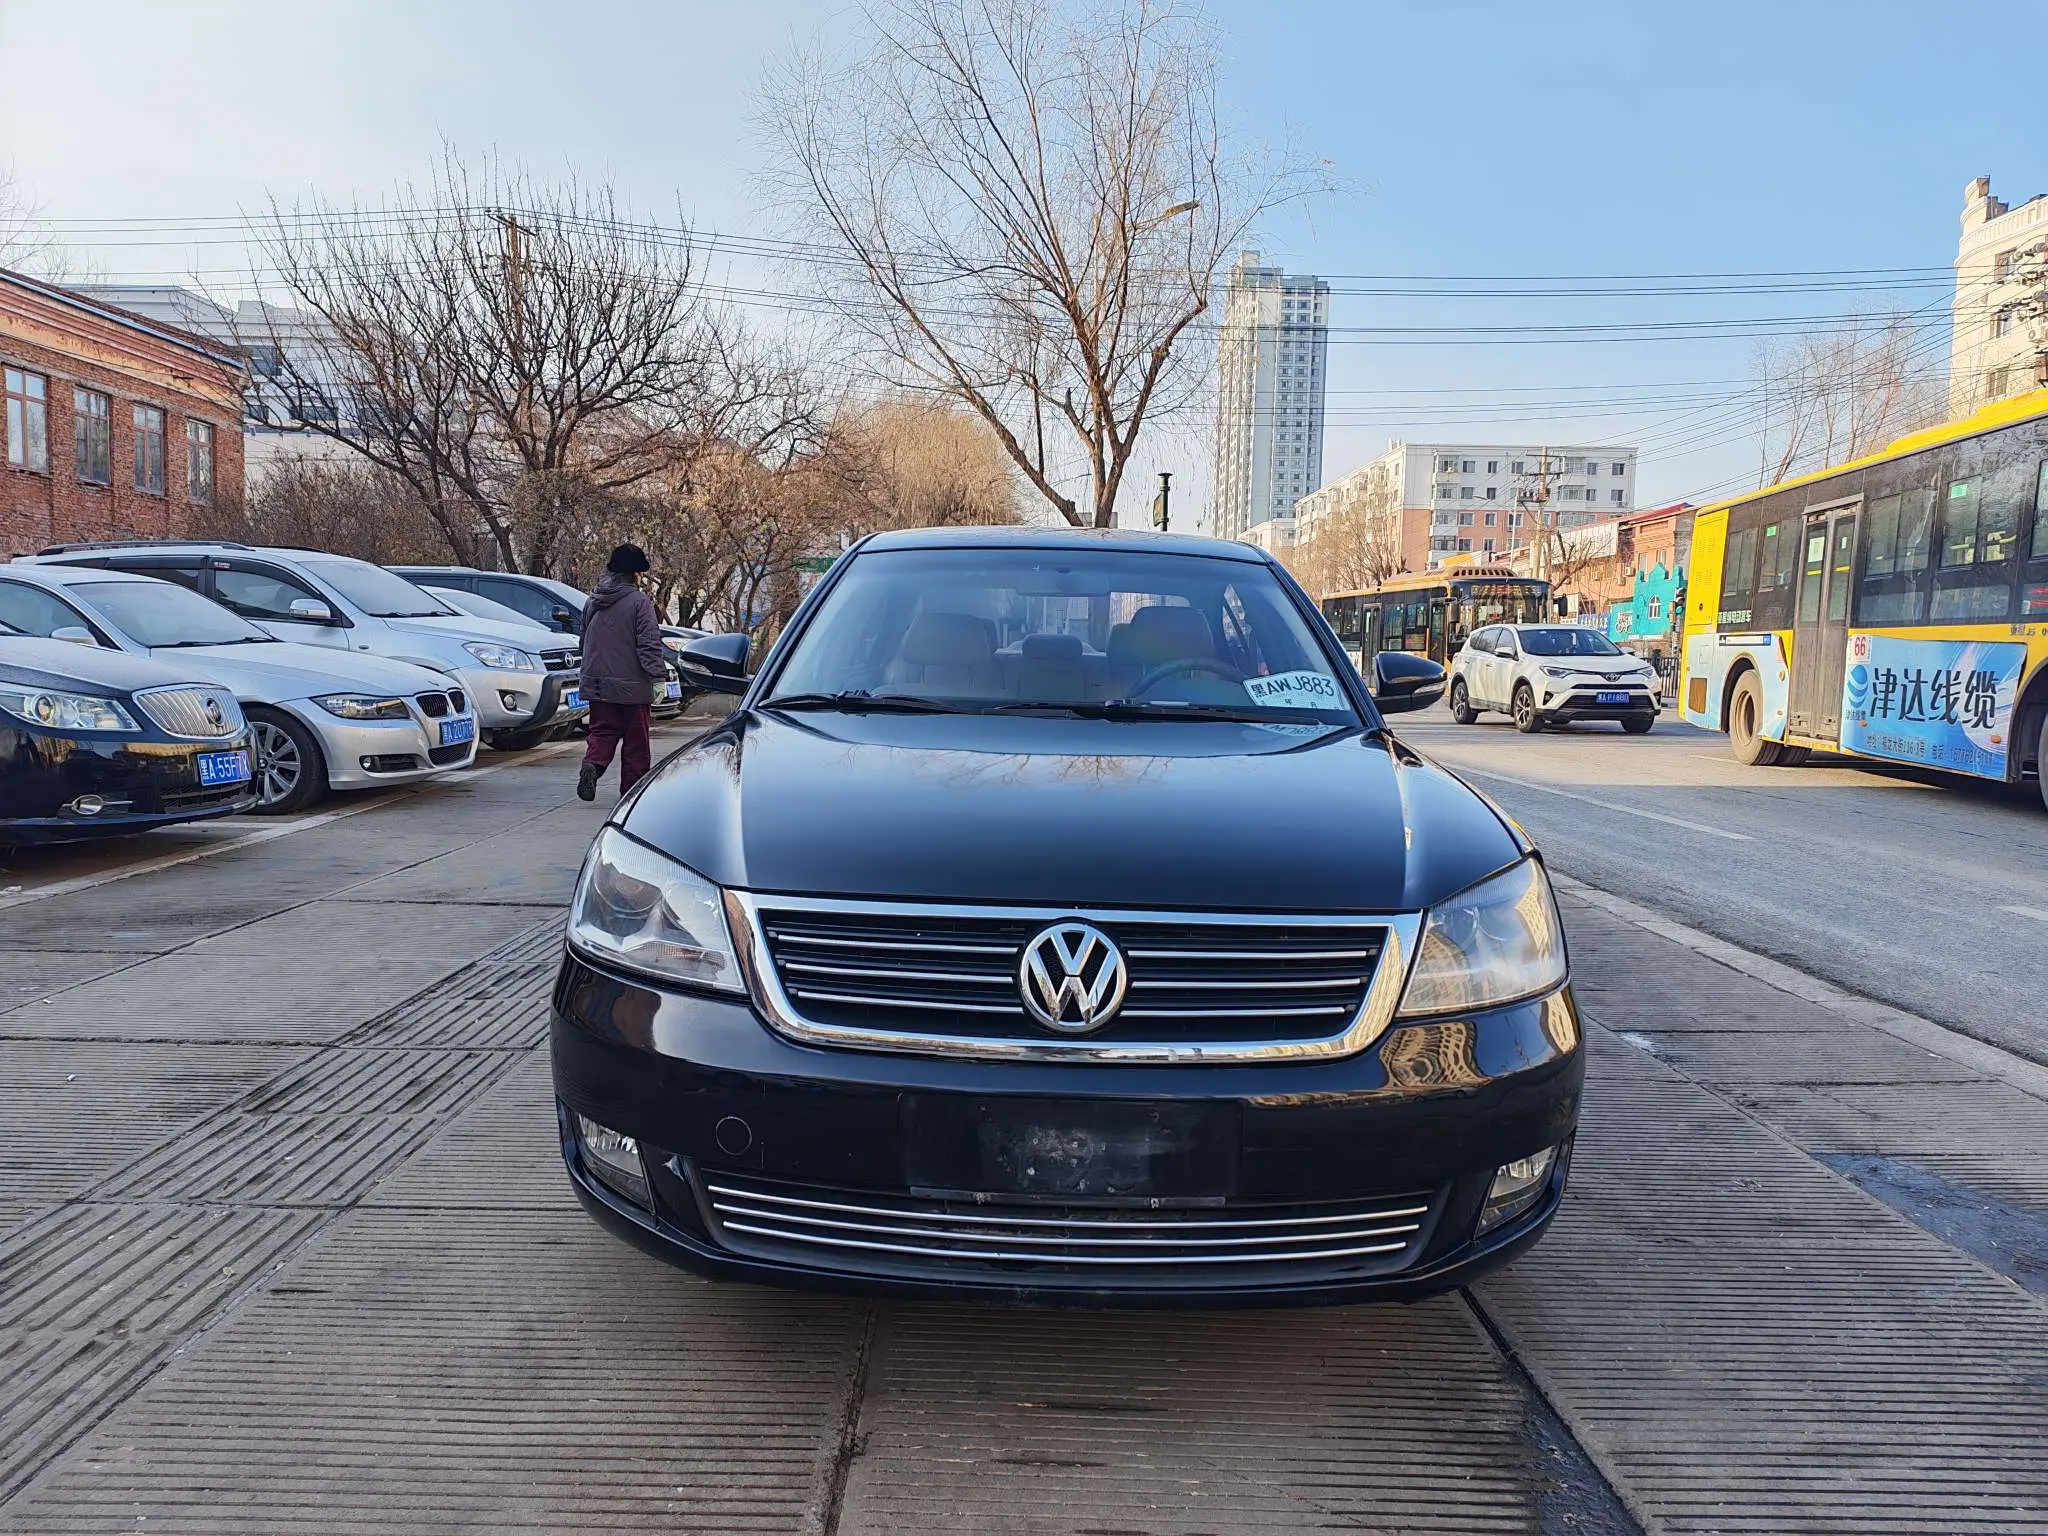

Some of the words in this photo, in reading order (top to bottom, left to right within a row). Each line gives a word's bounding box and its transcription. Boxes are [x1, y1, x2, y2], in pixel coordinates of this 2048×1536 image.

[1854, 636, 1866, 656] 66
[1250, 676, 1335, 698] 黑AWJ883
[1870, 667, 2001, 729] 津达线缆
